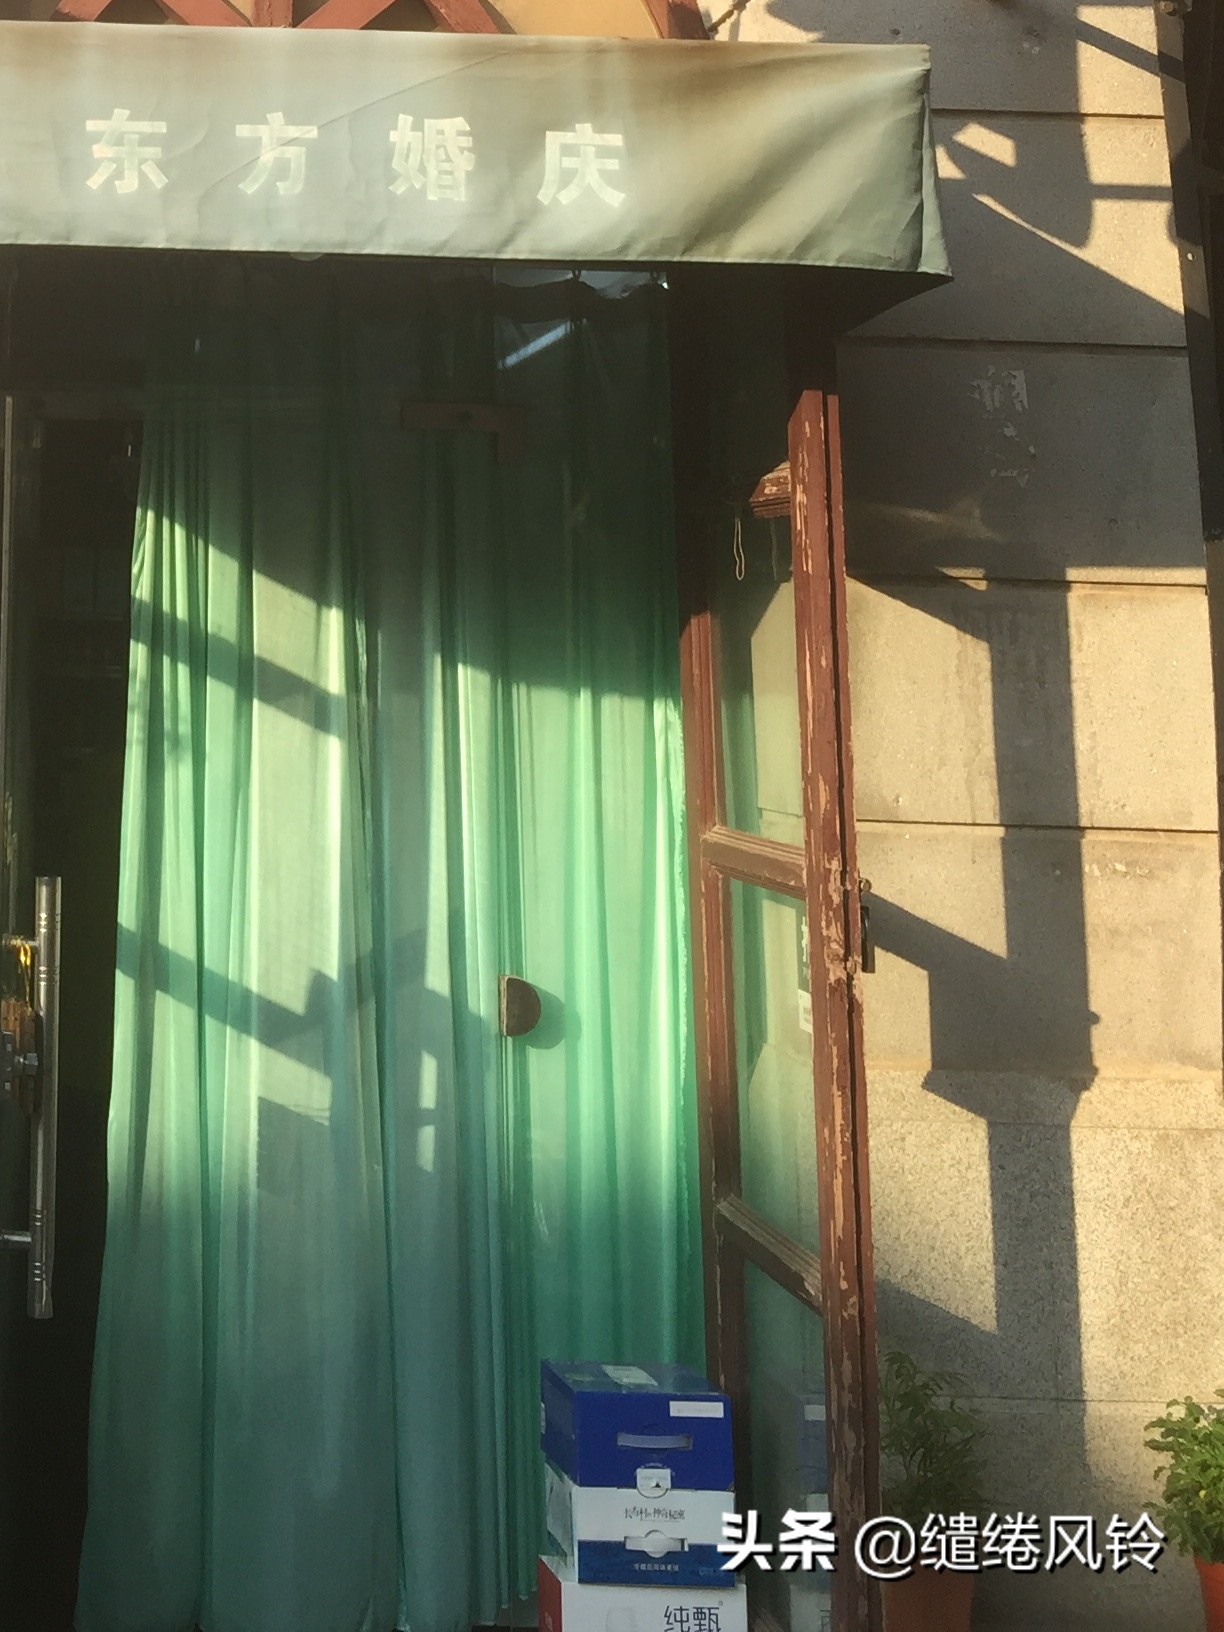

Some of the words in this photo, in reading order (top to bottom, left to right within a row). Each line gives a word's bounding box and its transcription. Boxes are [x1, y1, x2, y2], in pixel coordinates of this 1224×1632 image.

[85, 108, 627, 208] 东方婚庆
[663, 1605, 722, 1632] 纯甄
